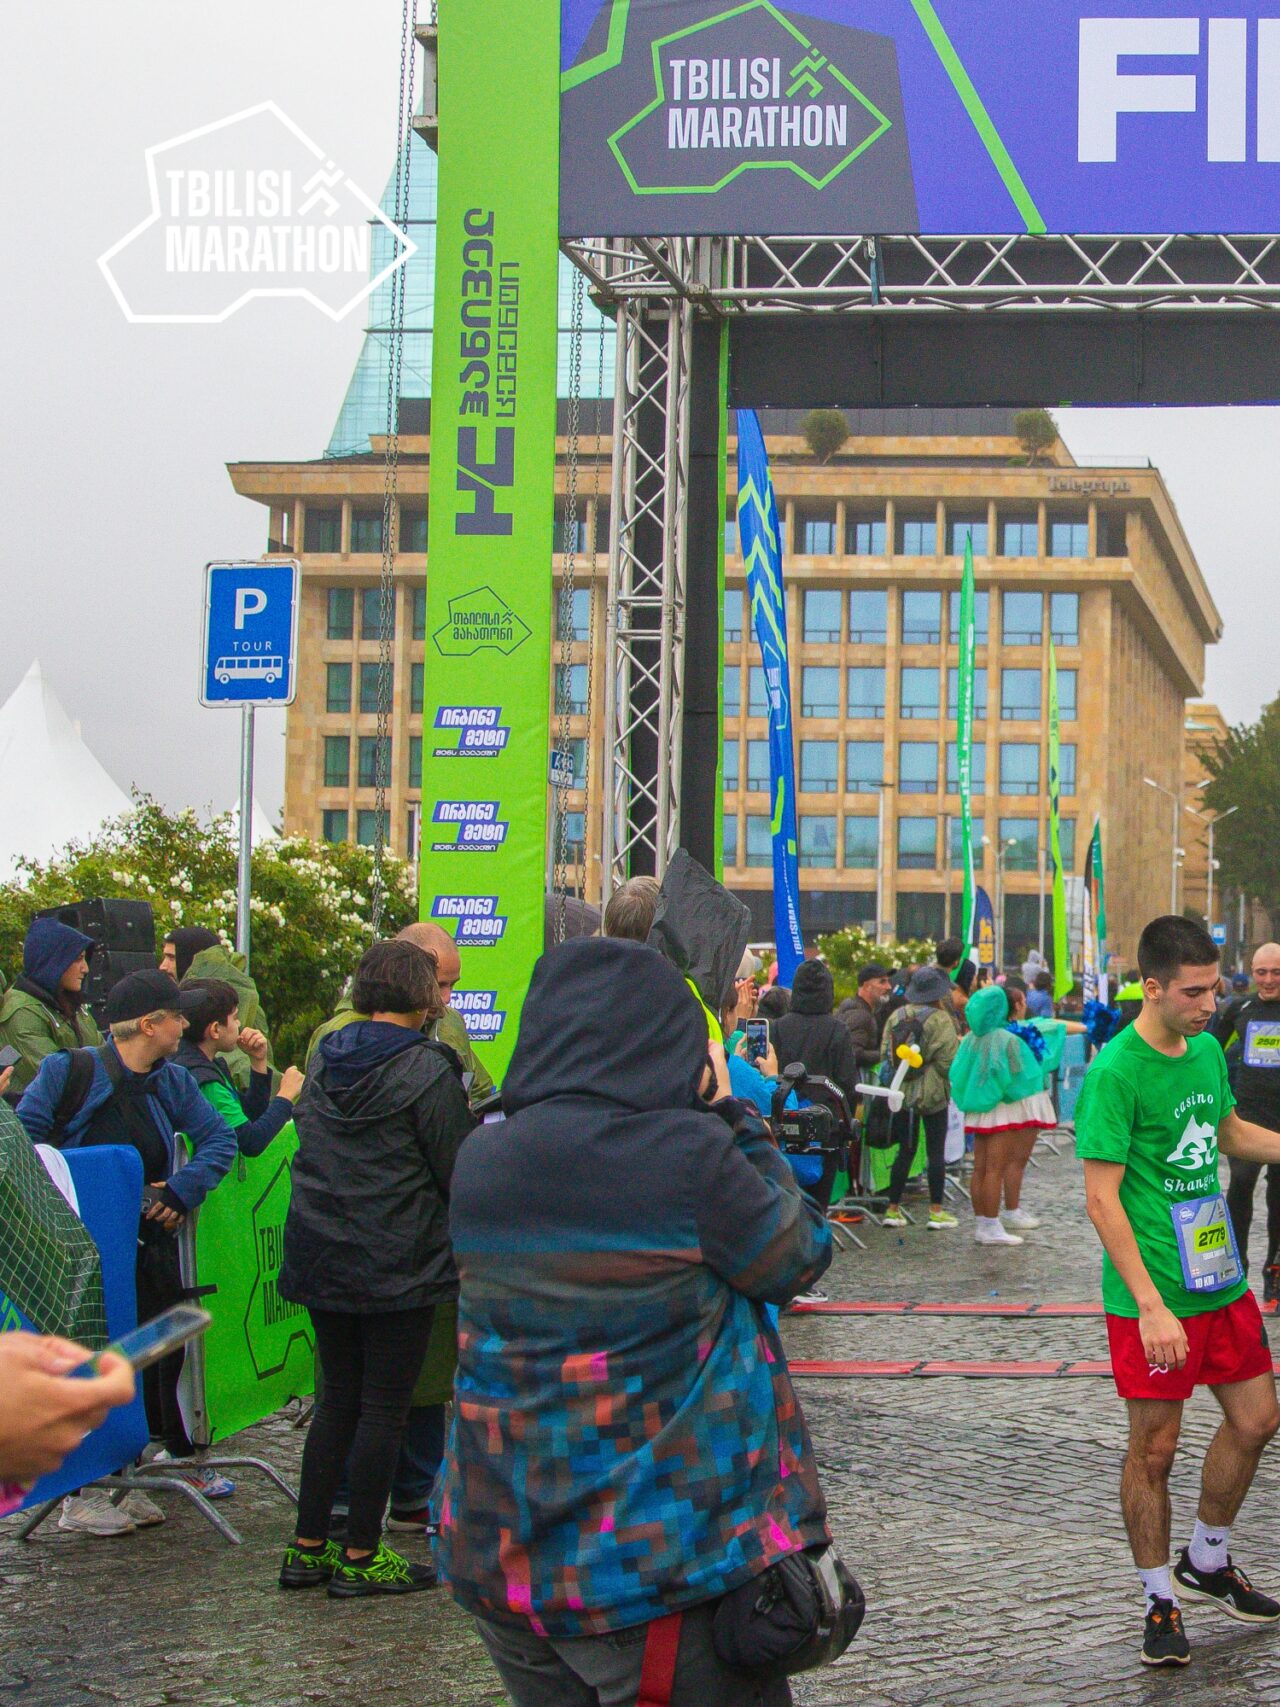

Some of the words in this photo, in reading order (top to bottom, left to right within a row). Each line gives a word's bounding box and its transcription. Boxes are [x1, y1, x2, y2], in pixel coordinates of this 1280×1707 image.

[668, 57, 782, 100] TBILISI
[667, 103, 848, 150] MARATHON
[495, 262, 520, 418] ცემენტი
[1048, 476, 1131, 496] Telegraph
[234, 587, 268, 630] P
[453, 612, 500, 626] თბილისი
[453, 627, 513, 641] მარათონი
[233, 640, 272, 652] TOUR
[440, 708, 497, 726] ირბინე
[465, 729, 506, 746] მეტი
[439, 803, 495, 820] ირბინე
[463, 823, 504, 841] მეტი
[437, 897, 493, 915] ირბინე
[462, 918, 503, 936] მეტი
[824, 1078, 844, 1099] RONIN
[1174, 1090, 1214, 1119] casino
[1198, 1227, 1226, 1248] 2779
[1194, 1276, 1204, 1288] 10
[1203, 1274, 1215, 1287] KM
